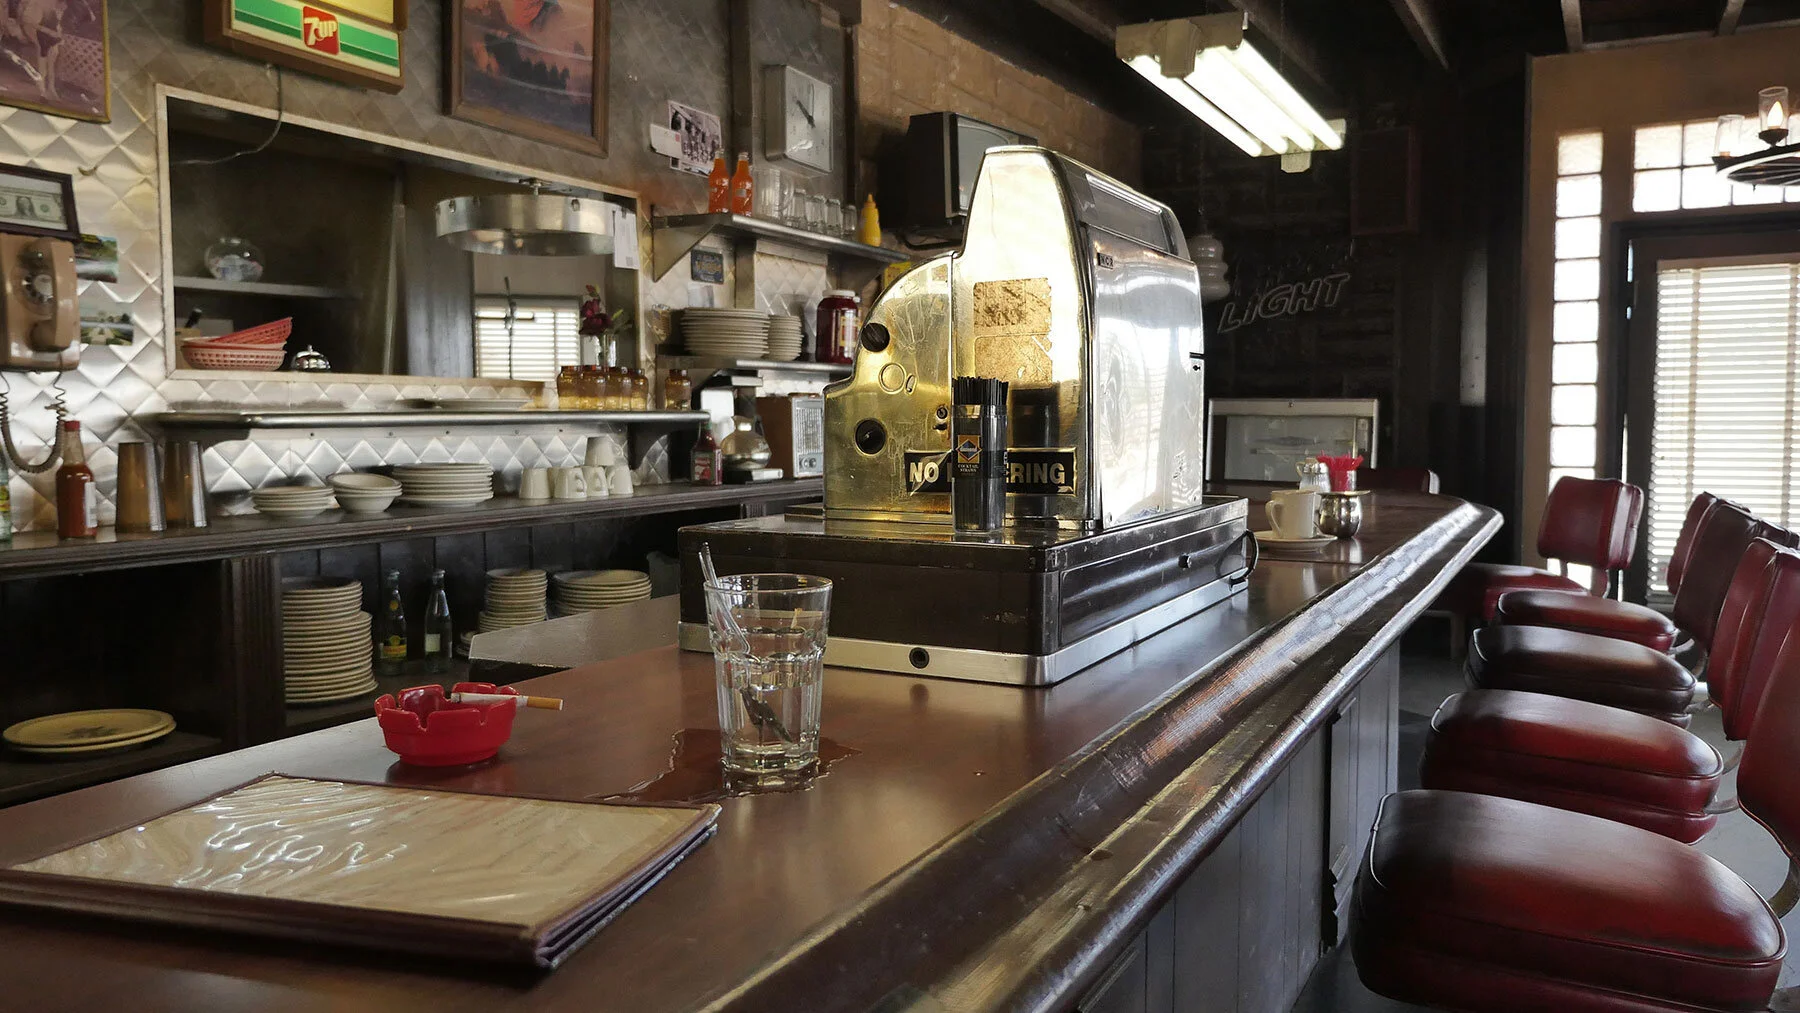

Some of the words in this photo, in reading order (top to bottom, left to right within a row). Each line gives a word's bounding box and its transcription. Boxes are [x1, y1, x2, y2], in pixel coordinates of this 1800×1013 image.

[304, 17, 338, 46] 7UP
[1217, 272, 1351, 334] LIGHT
[909, 461, 940, 483] NO
